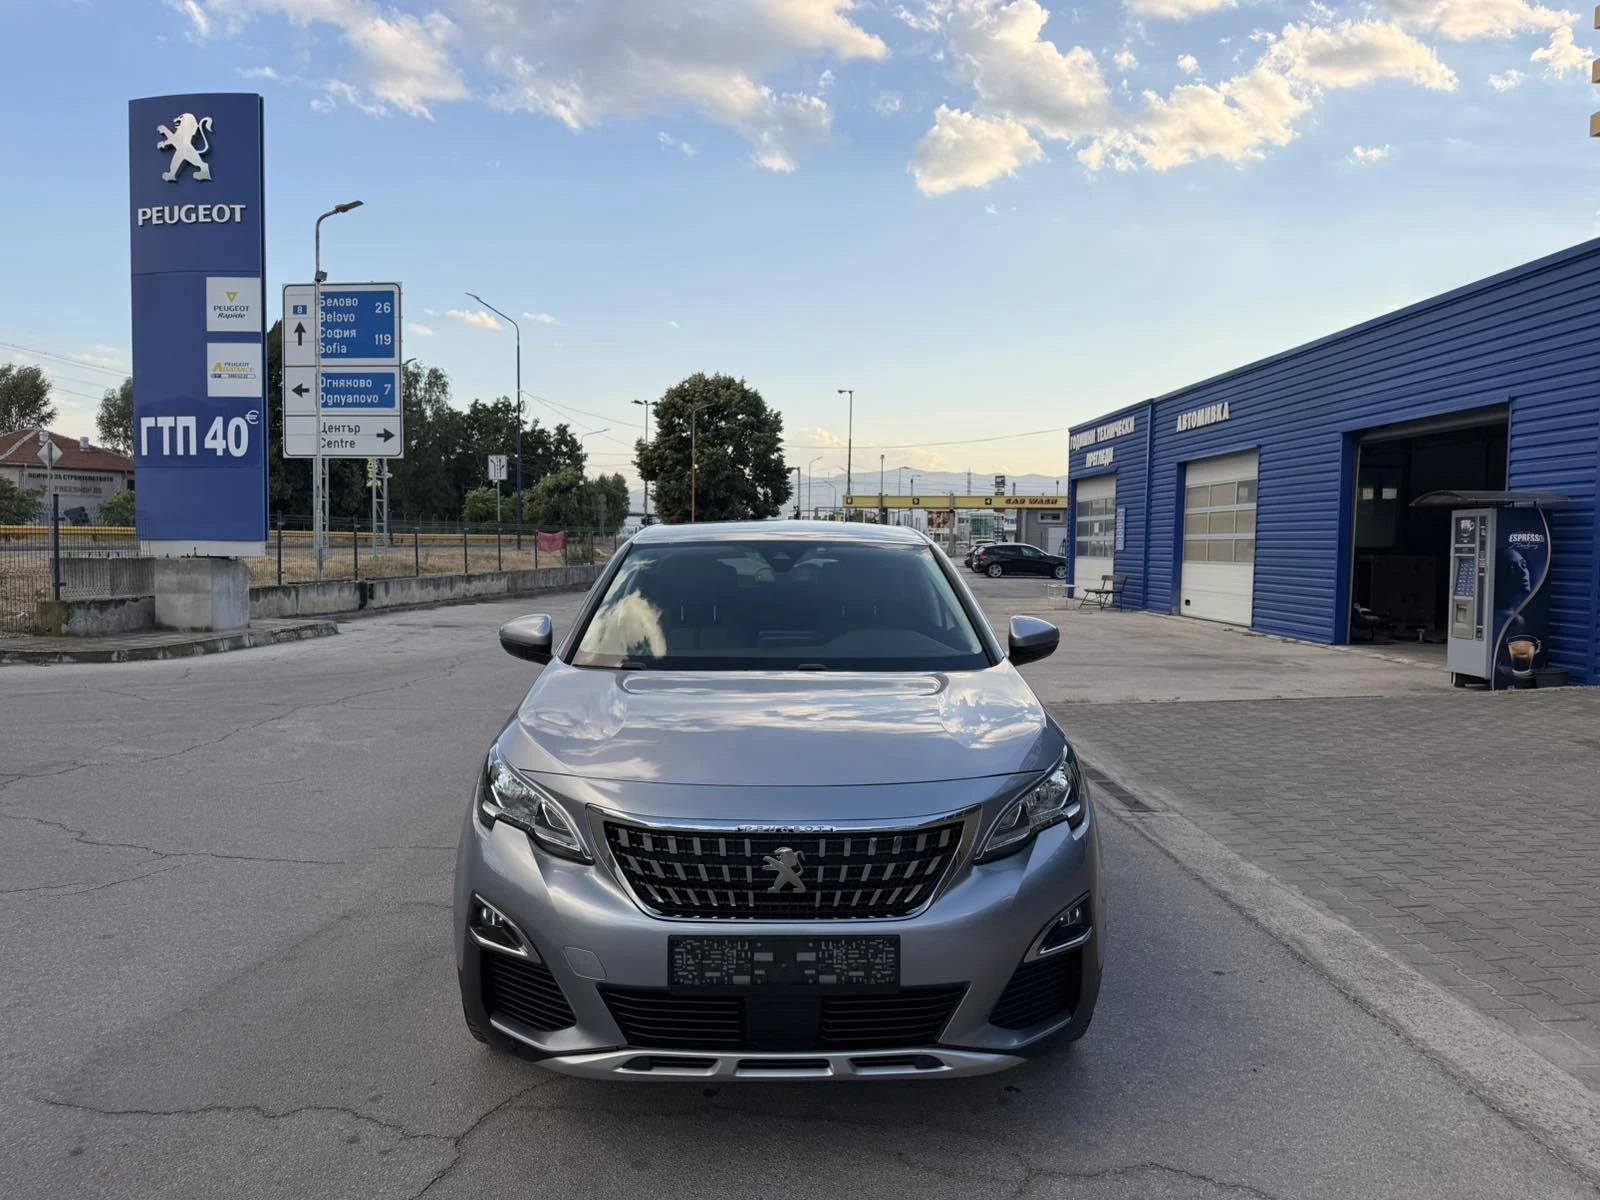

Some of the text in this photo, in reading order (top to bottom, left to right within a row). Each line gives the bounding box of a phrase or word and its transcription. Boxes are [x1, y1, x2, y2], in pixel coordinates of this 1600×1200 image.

[137, 203, 246, 226] PEUGEOT
[320, 295, 391, 314] Белово 26
[217, 312, 246, 320] Rapide
[320, 310, 356, 322] Belovo
[320, 326, 391, 346] София 119
[320, 342, 347, 354] Sofia
[320, 376, 373, 388] Огняново
[383, 384, 392, 395] 7
[320, 392, 379, 406] Ognyanovo
[1176, 401, 1230, 433] АВТОМИВКА
[140, 416, 197, 456] ГТП
[1097, 415, 1135, 443] ТЕХНИЧЕСКИ
[744, 825, 825, 833] PEUGEOT
